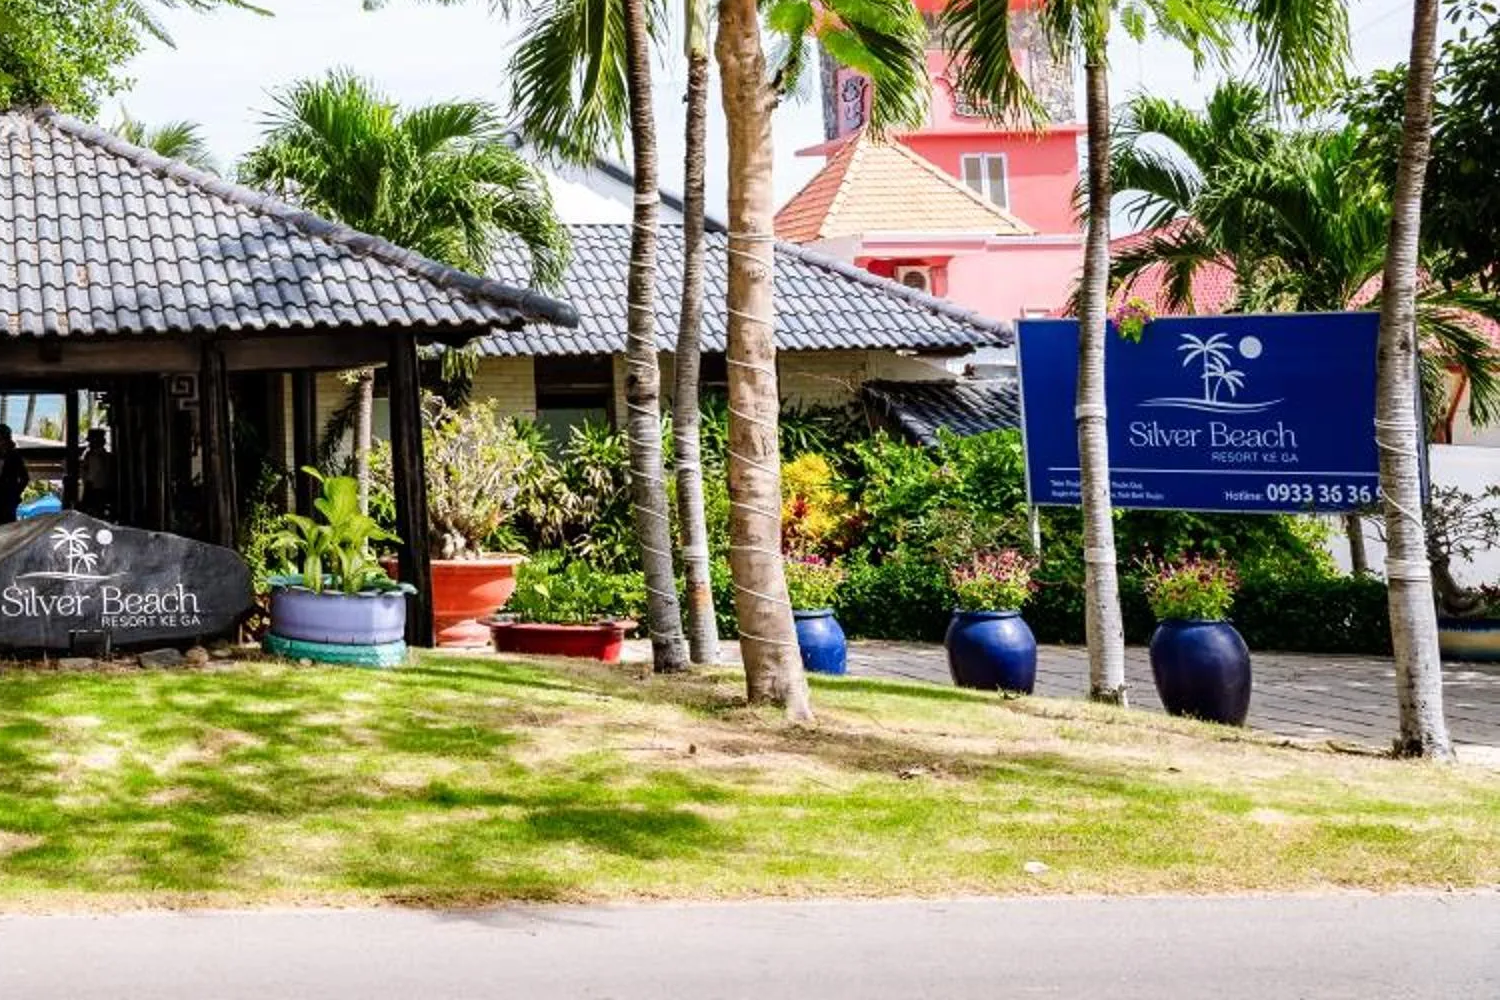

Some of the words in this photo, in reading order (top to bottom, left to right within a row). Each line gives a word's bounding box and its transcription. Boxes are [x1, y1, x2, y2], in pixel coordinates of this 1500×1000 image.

[1129, 421, 1202, 448] Silver
[1209, 421, 1298, 448] Beach
[1211, 451, 1258, 463] RESORT
[1225, 491, 1263, 502] Hotline:
[1266, 483, 1313, 502] 0933
[1318, 485, 1343, 503] 36
[1347, 485, 1372, 503] 36
[1, 586, 90, 617] Silver
[100, 584, 201, 615] Beach
[101, 616, 156, 628] RESORT
[159, 616, 177, 627] KE
[181, 616, 201, 627] GA
